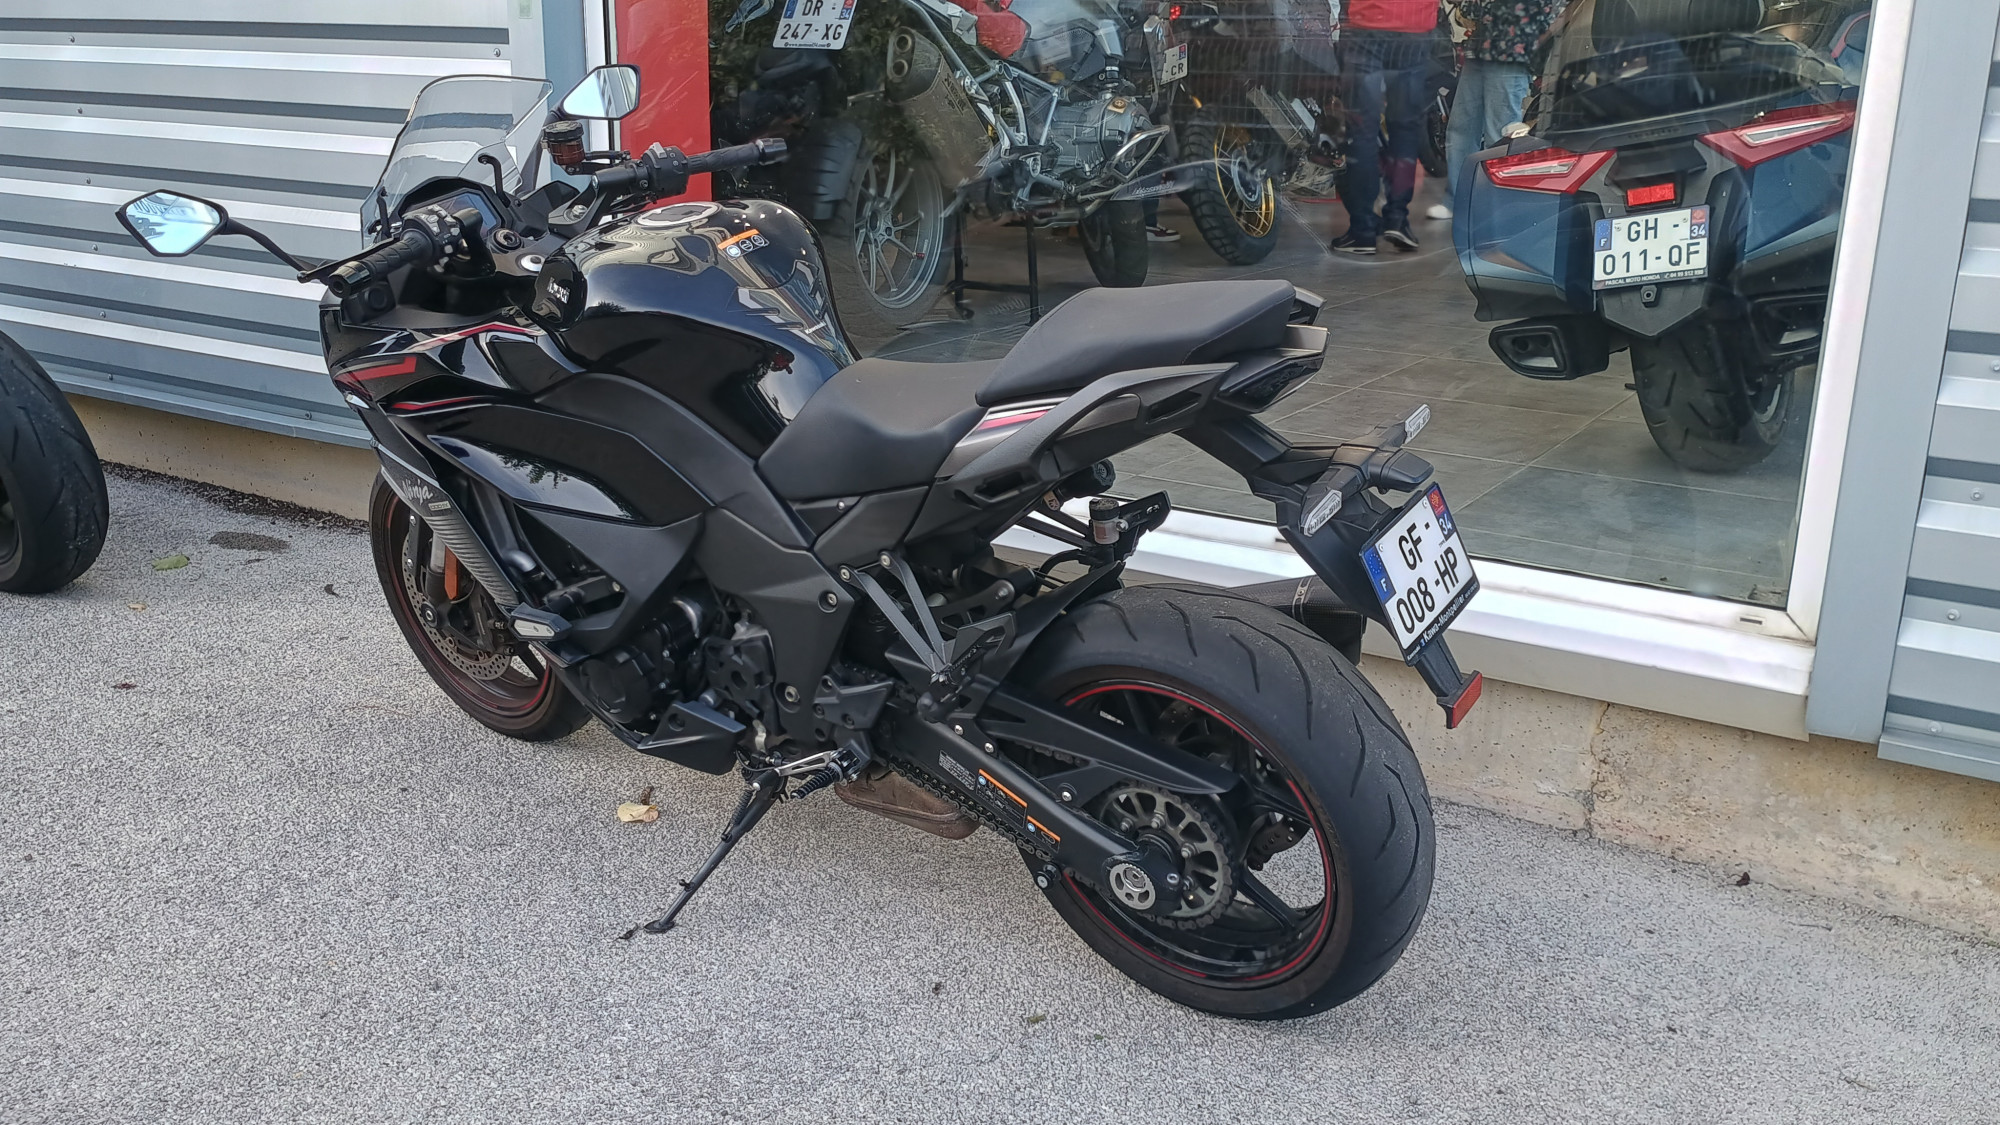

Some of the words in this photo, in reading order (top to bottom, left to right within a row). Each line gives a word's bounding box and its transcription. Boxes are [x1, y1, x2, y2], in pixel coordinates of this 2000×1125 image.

[802, 0, 823, 16] DR
[841, 10, 850, 19] 34
[780, 23, 843, 41] 247-XG
[1627, 217, 1658, 242] GH
[1691, 224, 1706, 238] 34
[1600, 238, 1607, 247] F
[1602, 241, 1700, 276] 011-QF
[1605, 278, 1625, 286] PASCAL
[1641, 274, 1660, 282] HONDA
[402, 479, 433, 506] Ninja
[1438, 513, 1452, 535] 34
[1398, 522, 1423, 570] GF
[1380, 578, 1387, 592] F
[1396, 546, 1459, 635] 008-HP
